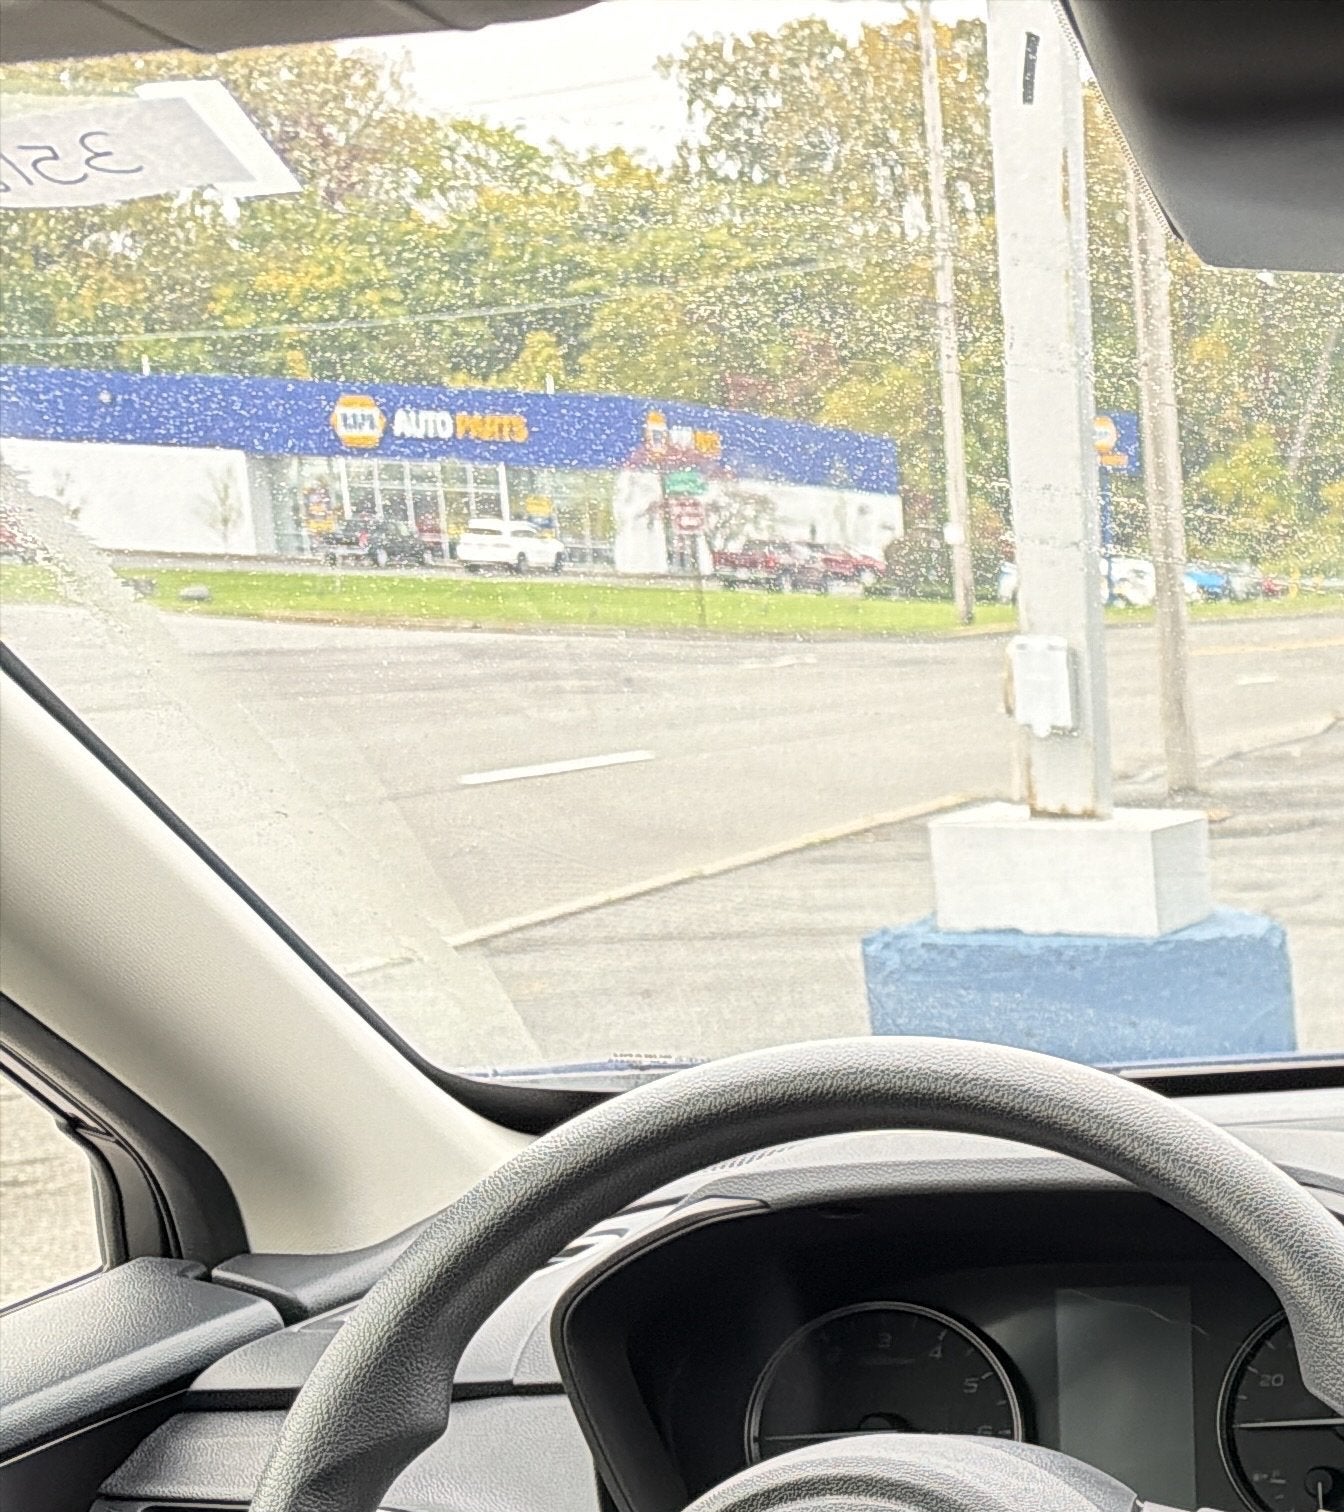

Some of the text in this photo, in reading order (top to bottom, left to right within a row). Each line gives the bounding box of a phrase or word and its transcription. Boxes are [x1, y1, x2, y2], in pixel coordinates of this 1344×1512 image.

[393, 408, 454, 439] AUTO
[455, 413, 529, 442] PARTS
[963, 1377, 978, 1394] 5
[1259, 1374, 1284, 1387] 20
